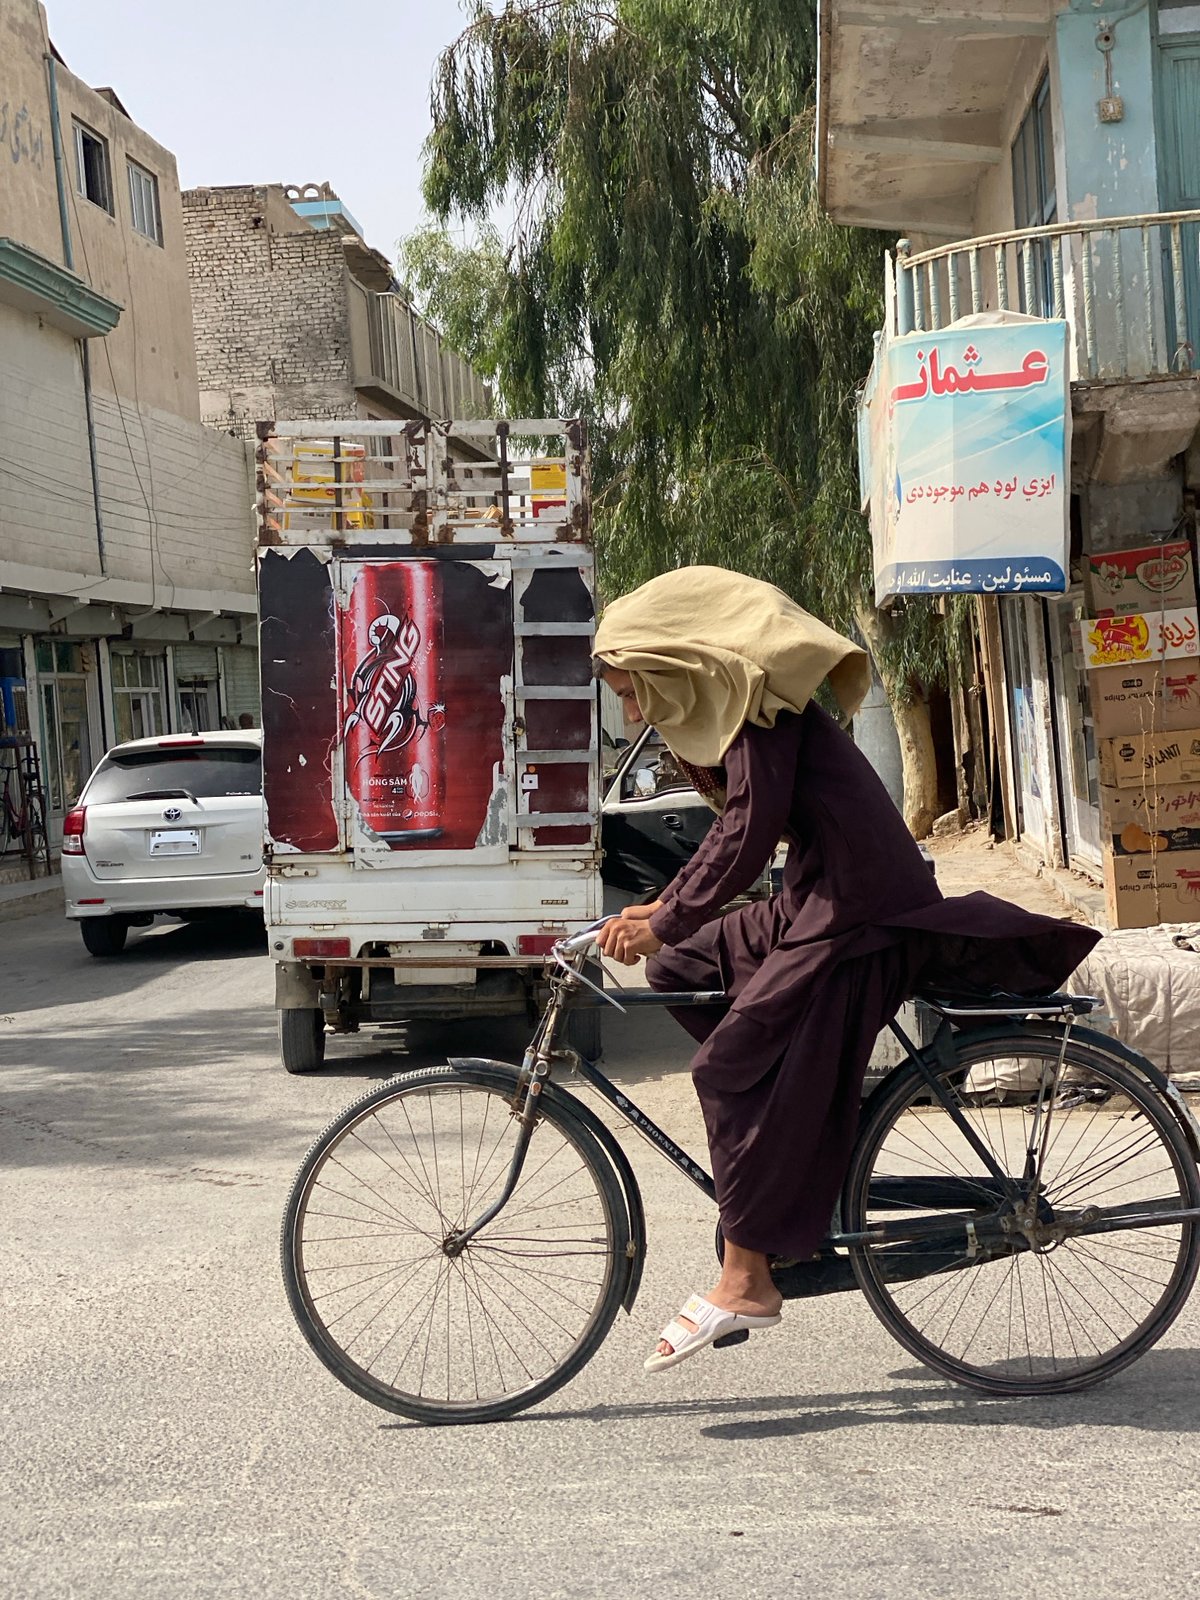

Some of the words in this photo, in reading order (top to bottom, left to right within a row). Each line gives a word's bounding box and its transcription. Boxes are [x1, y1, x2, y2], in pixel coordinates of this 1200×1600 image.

[968, 481, 990, 501] هم
[364, 621, 419, 732] STING
[1104, 693, 1126, 702] Chips
[1119, 884, 1140, 892] Chips
[639, 1119, 680, 1156] PHOENIX
